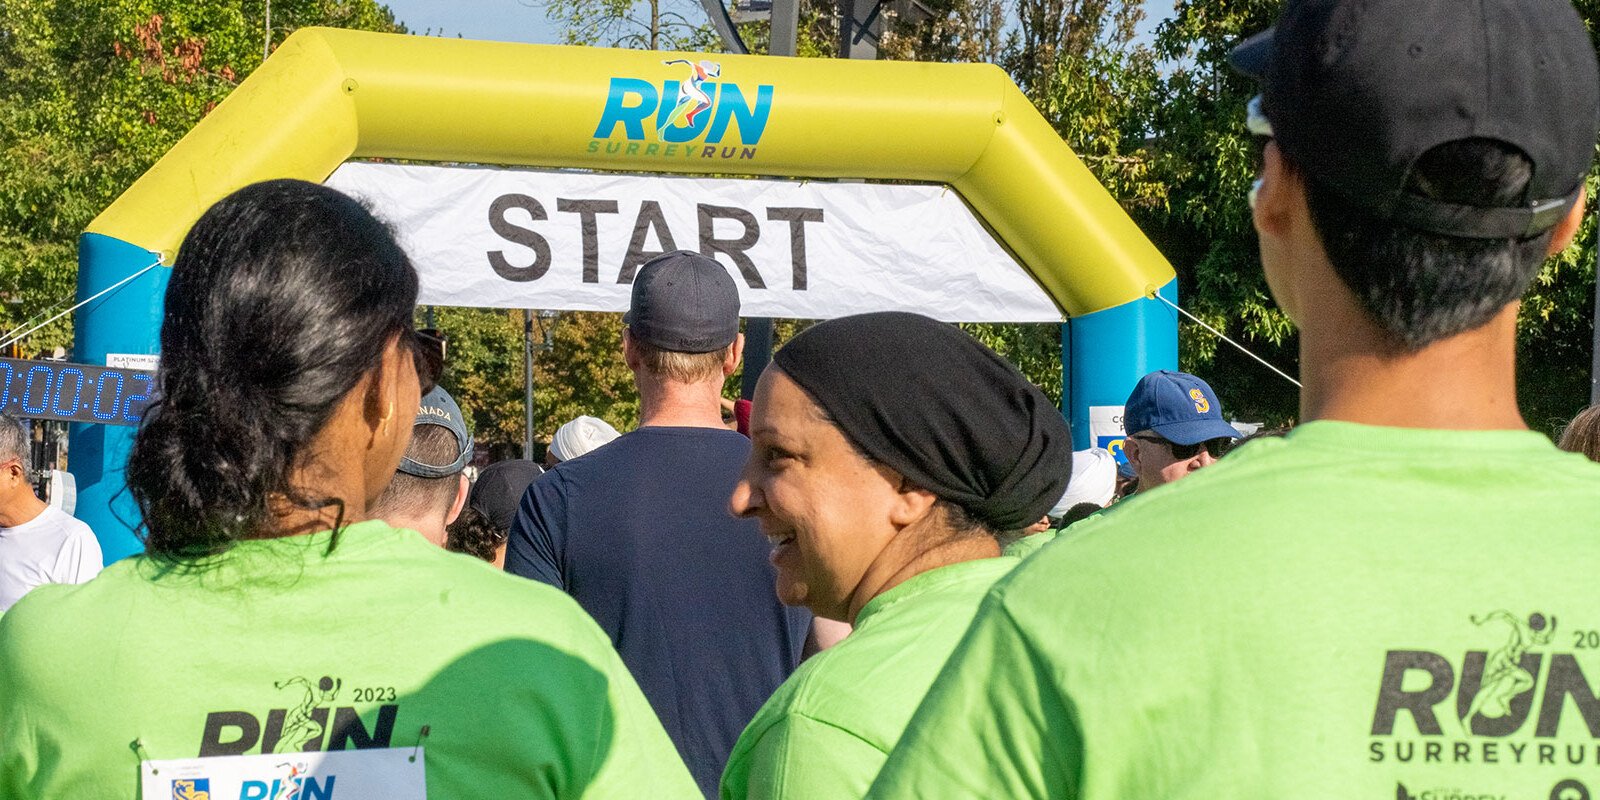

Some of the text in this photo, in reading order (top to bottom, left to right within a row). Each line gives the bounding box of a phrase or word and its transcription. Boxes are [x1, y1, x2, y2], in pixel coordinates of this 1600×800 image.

[592, 77, 775, 145] RUN
[486, 193, 825, 291] START
[1189, 388, 1210, 414] S
[353, 687, 397, 703] 2023
[1369, 742, 1600, 765] SURREYRU
